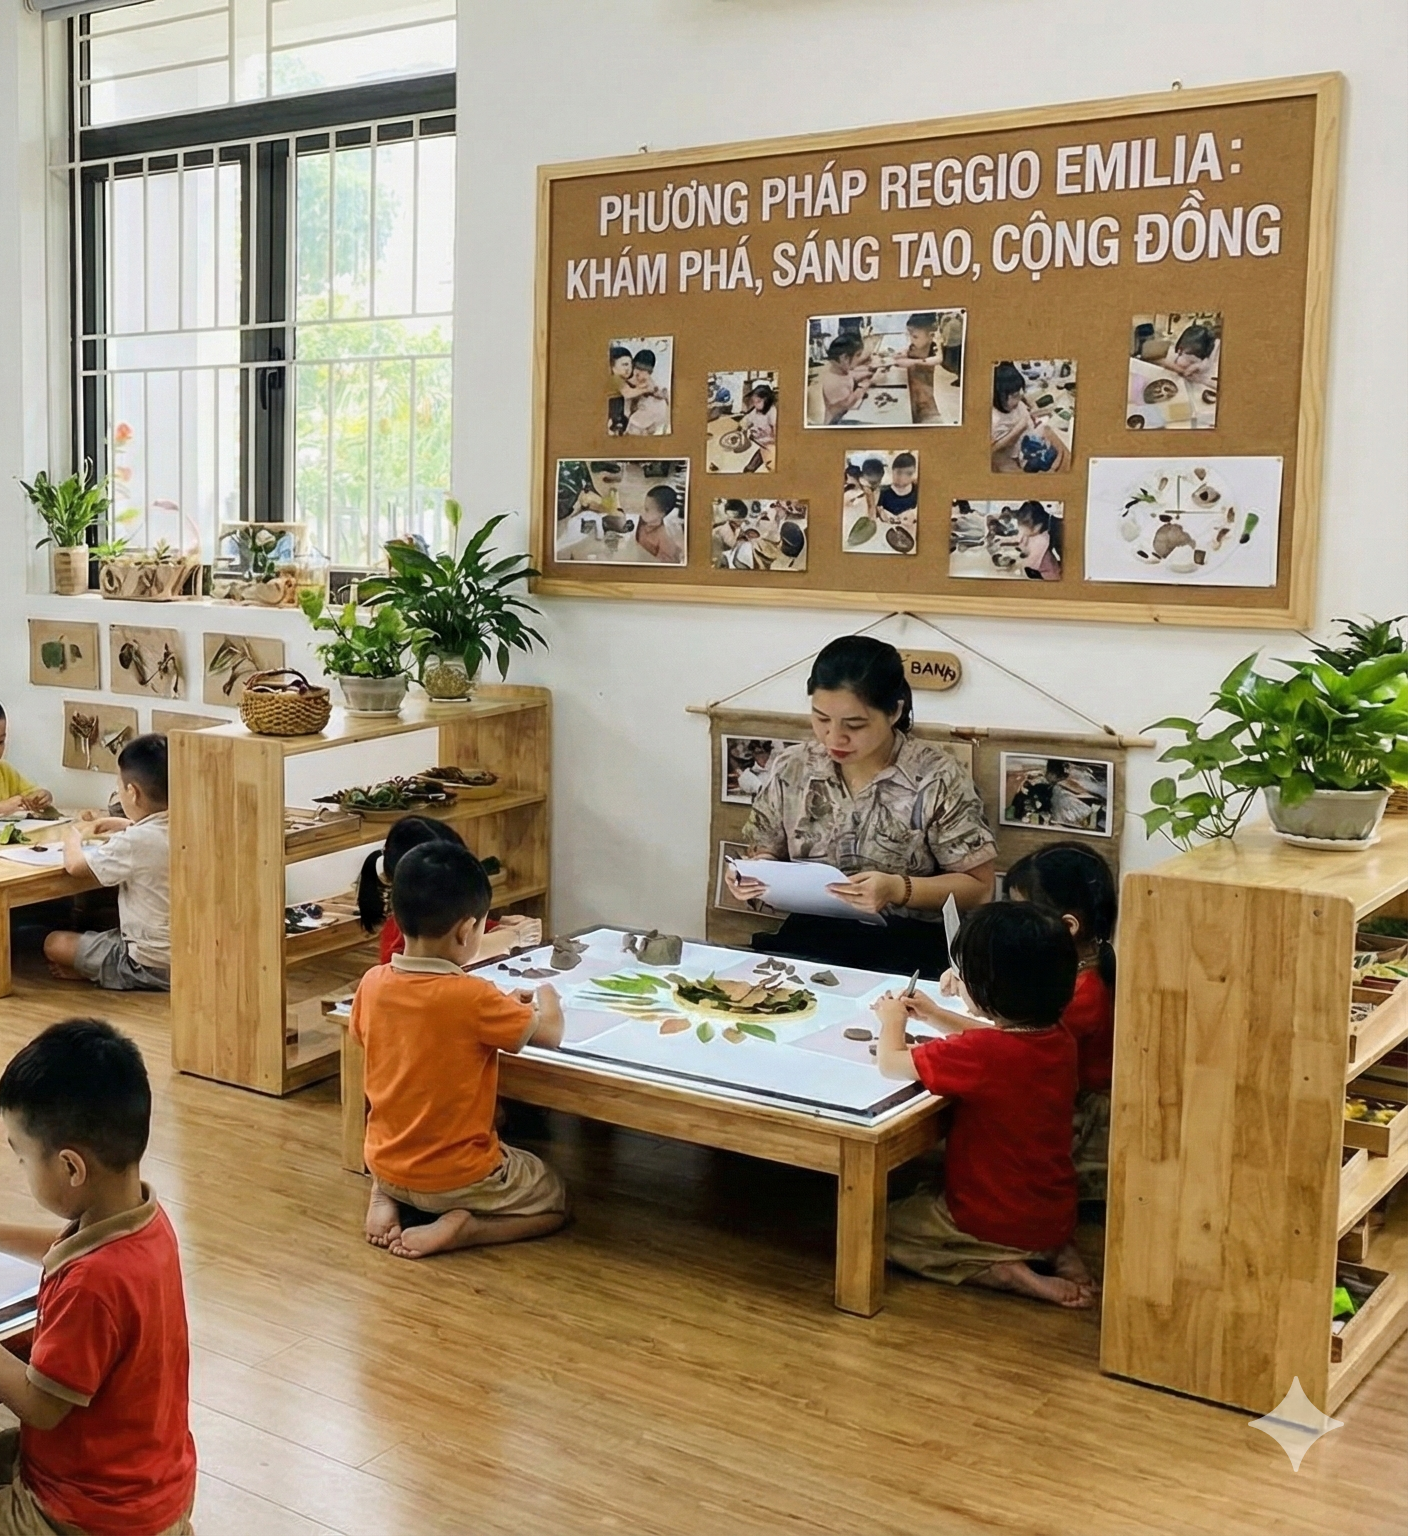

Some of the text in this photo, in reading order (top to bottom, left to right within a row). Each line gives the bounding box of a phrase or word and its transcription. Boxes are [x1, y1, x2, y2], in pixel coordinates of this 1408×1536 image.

[599, 132, 1243, 237] PHƯƠNG PHÁP REGGIO EMILIA:
[566, 189, 1282, 301] KHÁM PHÁ, SÁNG TẠO, CỘNG ĐỒNG
